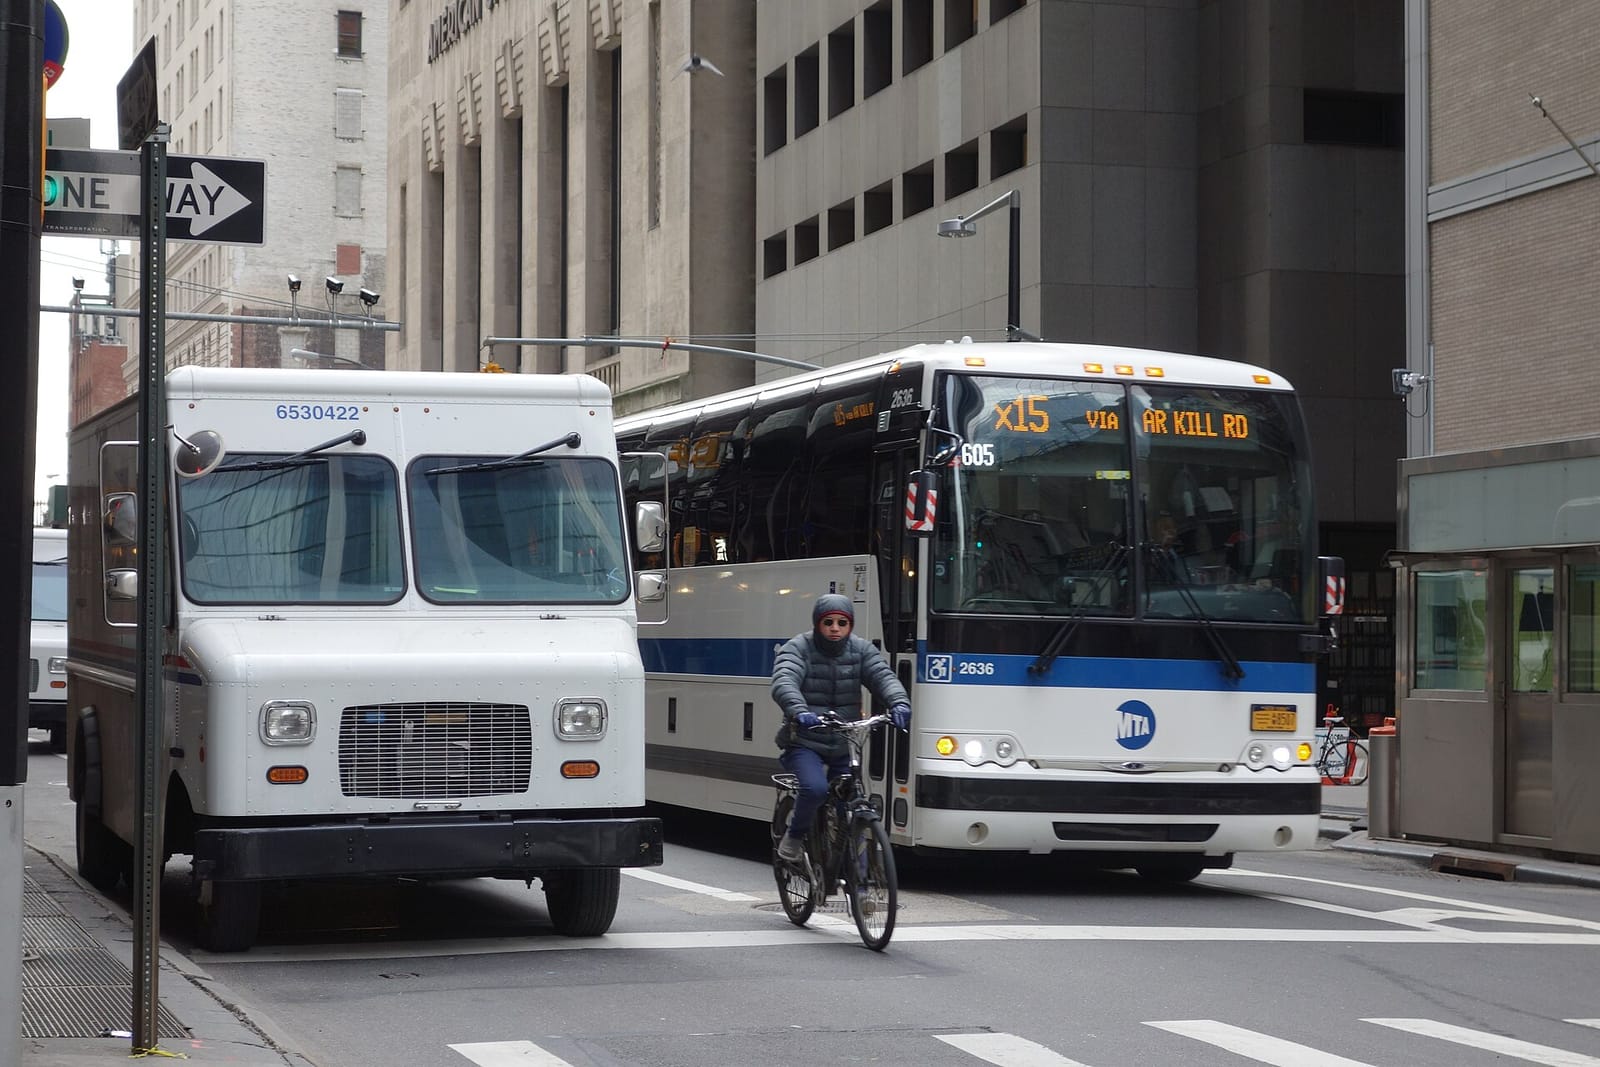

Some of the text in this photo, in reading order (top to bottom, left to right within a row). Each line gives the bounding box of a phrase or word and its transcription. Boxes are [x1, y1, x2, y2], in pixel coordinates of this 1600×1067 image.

[891, 388, 914, 408] 2636
[276, 404, 360, 421] 6530422
[1085, 410, 1119, 430] VIA
[1173, 410, 1218, 437] KILL
[1223, 413, 1248, 439] RD
[961, 443, 995, 466] 605
[959, 662, 995, 675] 2636
[1115, 710, 1151, 740] MTA
